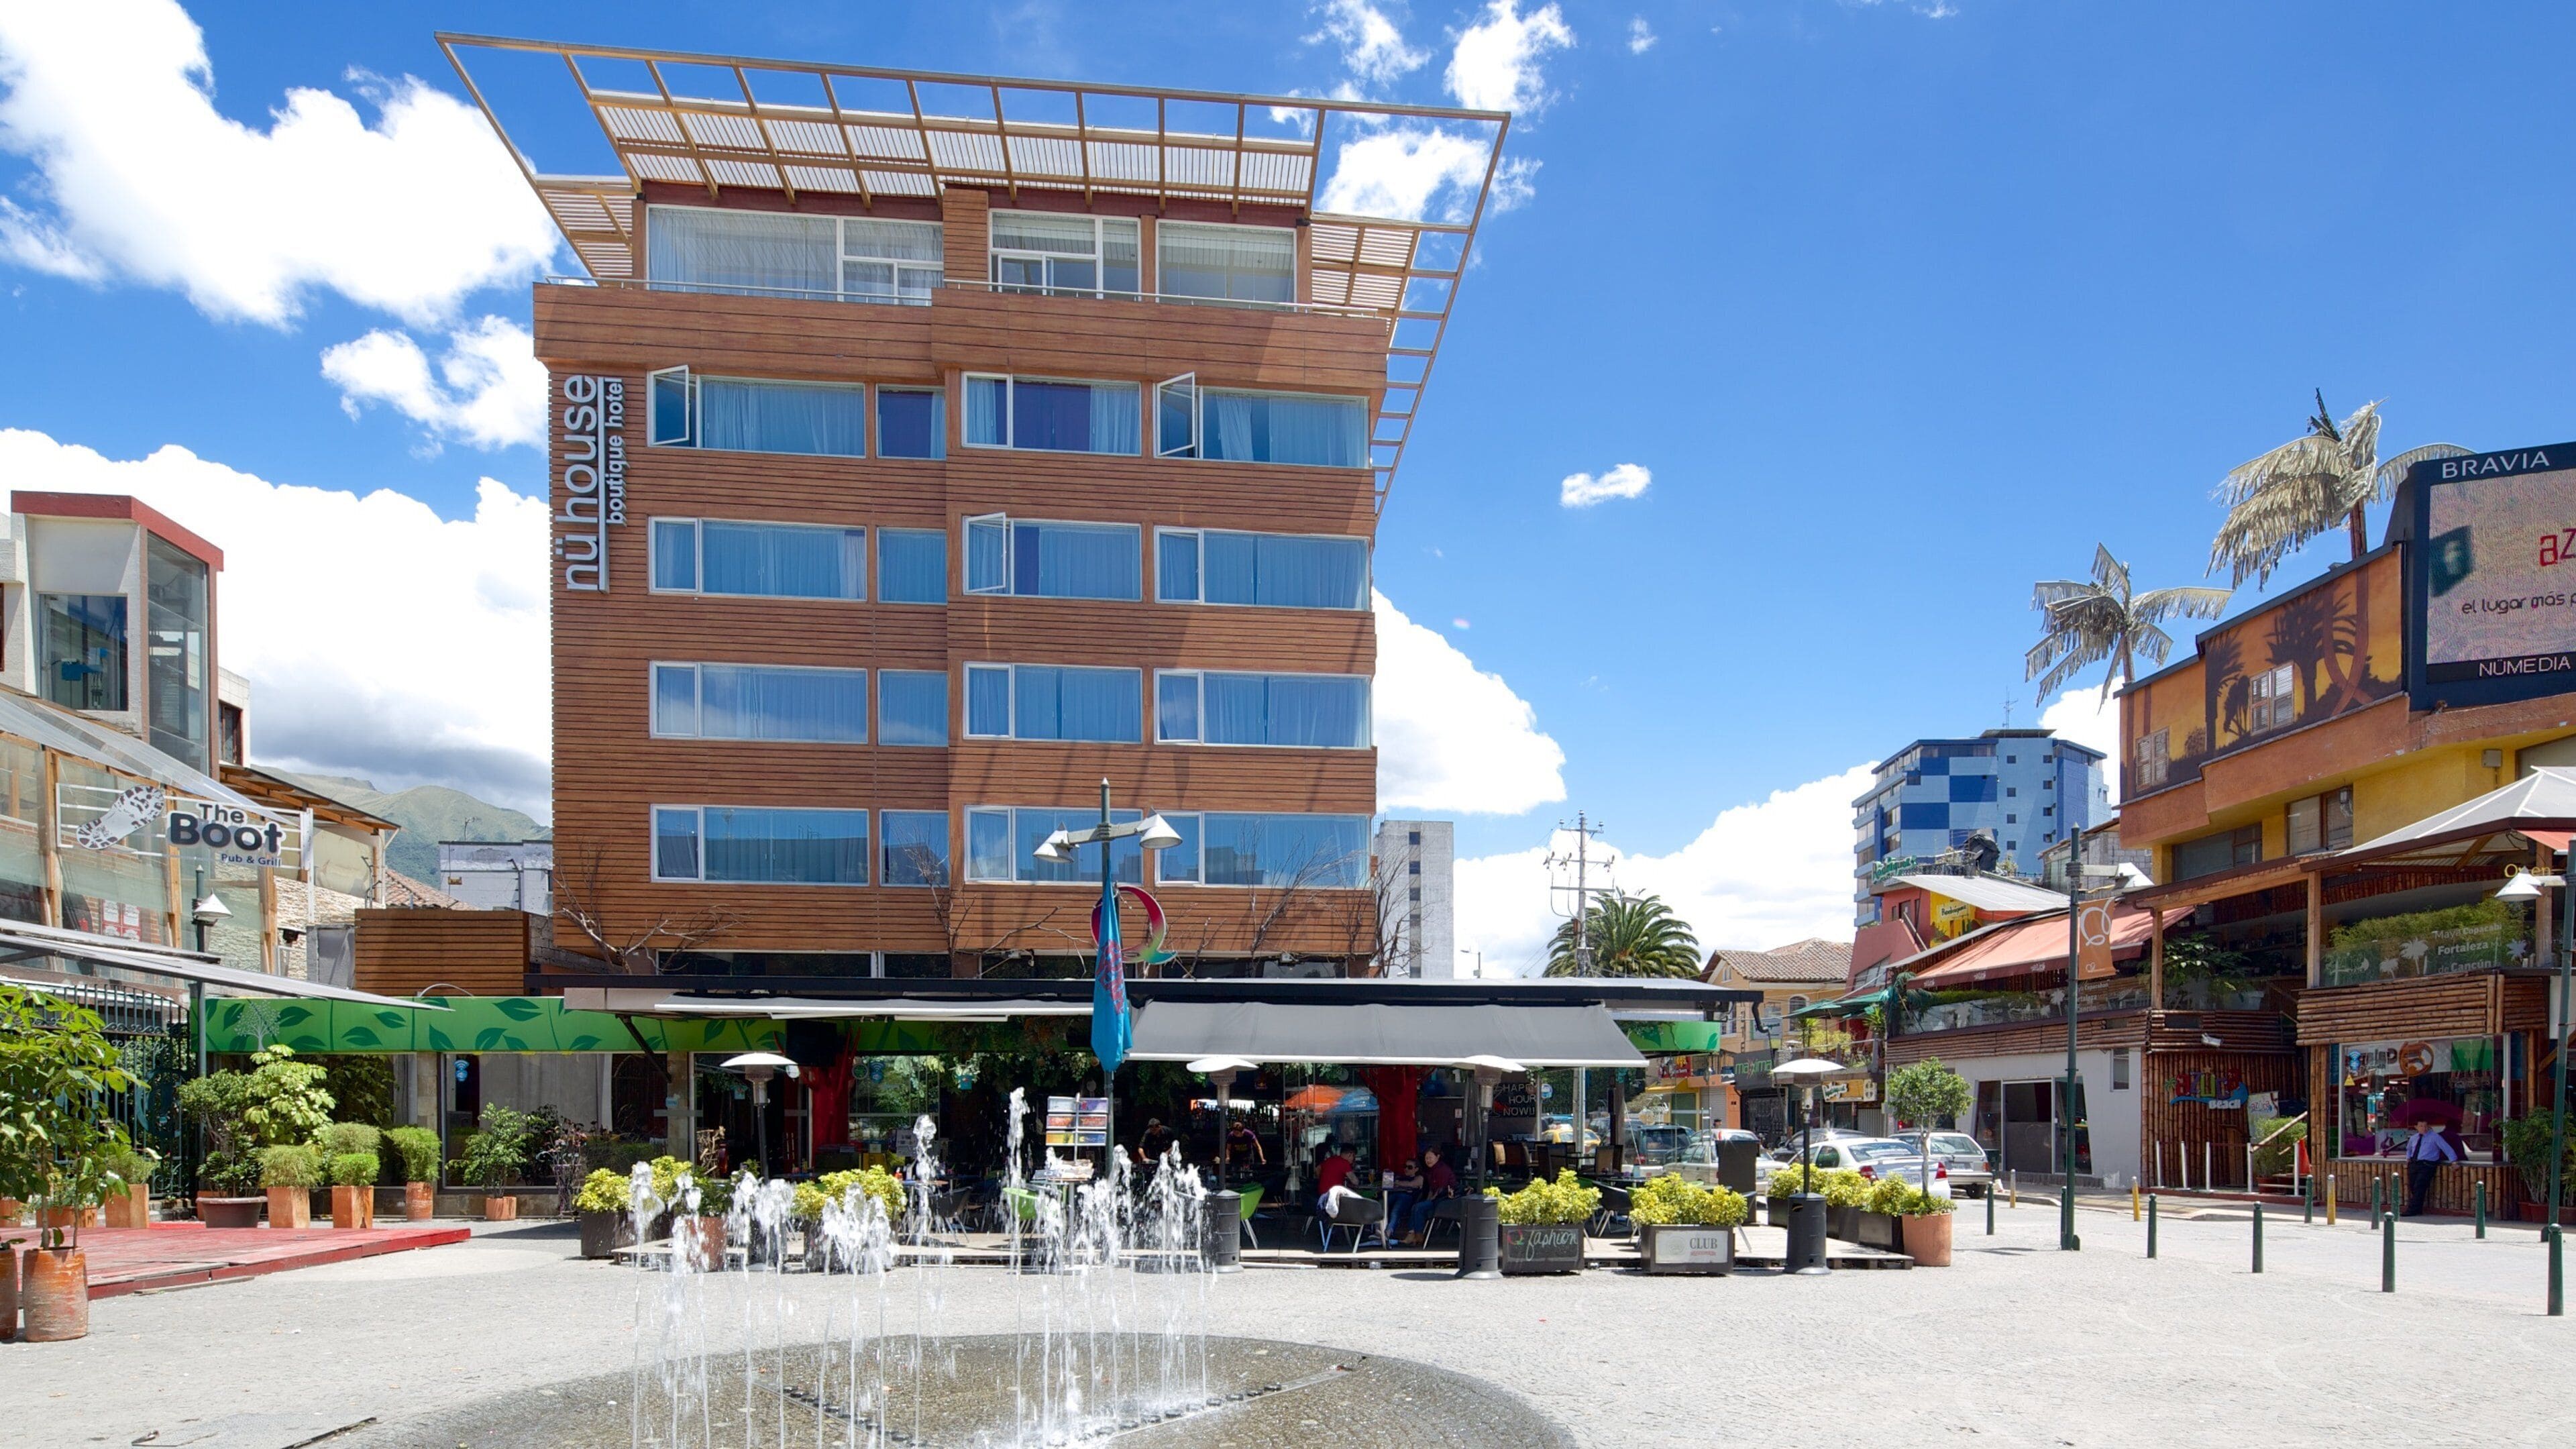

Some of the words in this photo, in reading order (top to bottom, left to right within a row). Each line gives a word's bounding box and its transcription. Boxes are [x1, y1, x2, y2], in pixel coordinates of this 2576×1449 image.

[604, 378, 625, 428] hotel
[555, 374, 598, 524] house
[2442, 451, 2550, 479] BRAVIA
[605, 435, 629, 525] boutique
[555, 534, 598, 591] nü
[2461, 599, 2477, 614] el
[2481, 598, 2527, 614] lugar
[2530, 591, 2565, 609] más
[2479, 655, 2571, 678] NÜMEDIA
[199, 803, 245, 824] The
[170, 812, 283, 853] Boot
[221, 853, 243, 863] Pub
[246, 855, 255, 864] &
[258, 857, 281, 867] Grill
[2504, 863, 2551, 877] Oen
[2437, 941, 2489, 956] Fortaleza
[2451, 959, 2491, 972] Cancún
[1508, 1094, 1536, 1104] HOUR
[1689, 1237, 1718, 1249] CLUB
